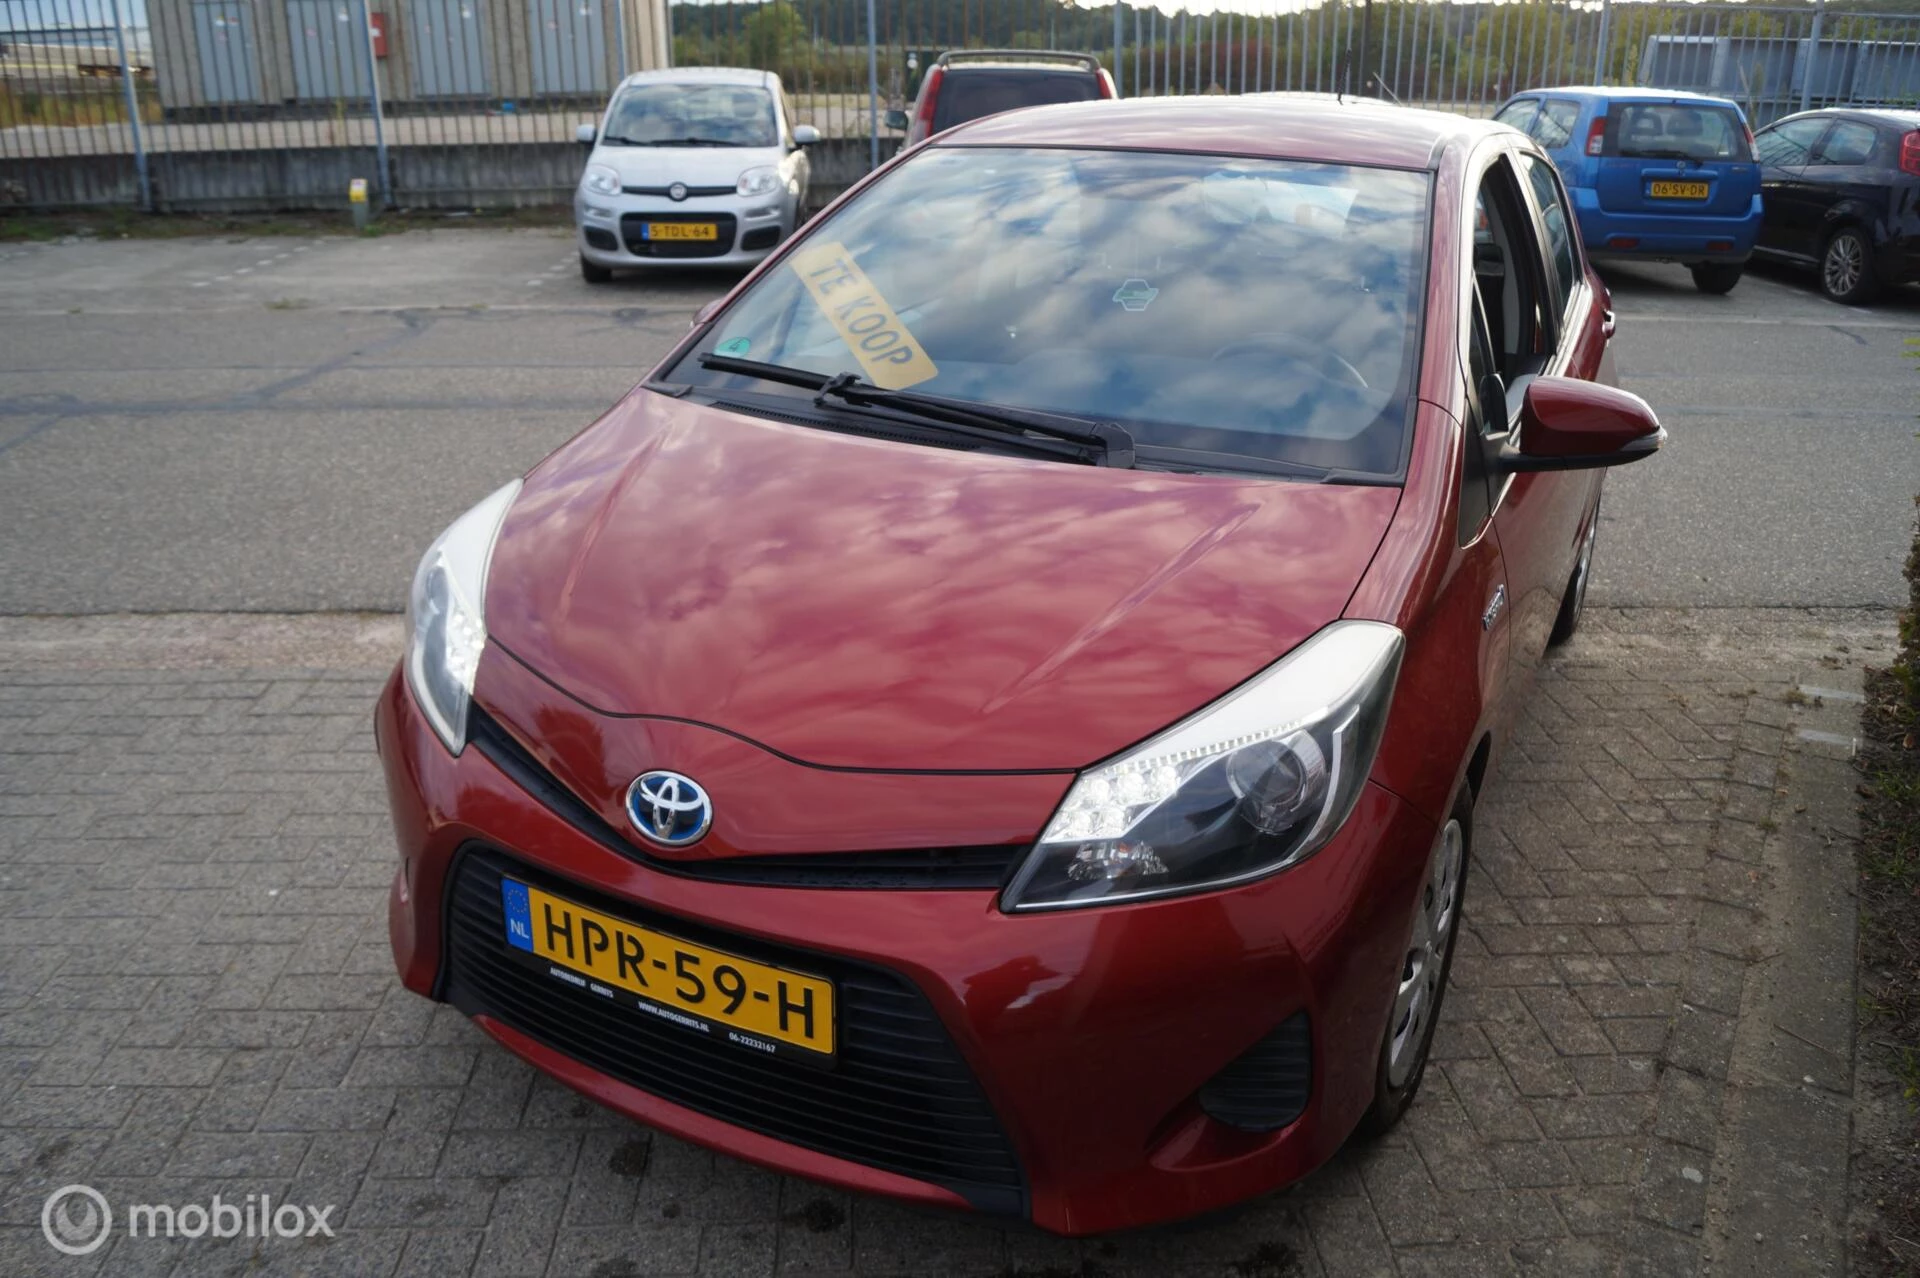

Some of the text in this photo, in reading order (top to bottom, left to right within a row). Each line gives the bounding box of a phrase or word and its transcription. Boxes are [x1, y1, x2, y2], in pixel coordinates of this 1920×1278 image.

[808, 258, 913, 364] TE KOOP
[510, 919, 529, 939] NL
[543, 902, 815, 1040] HPR-59-H
[638, 1001, 710, 1032] WWW.AUTOGERRITS.NL
